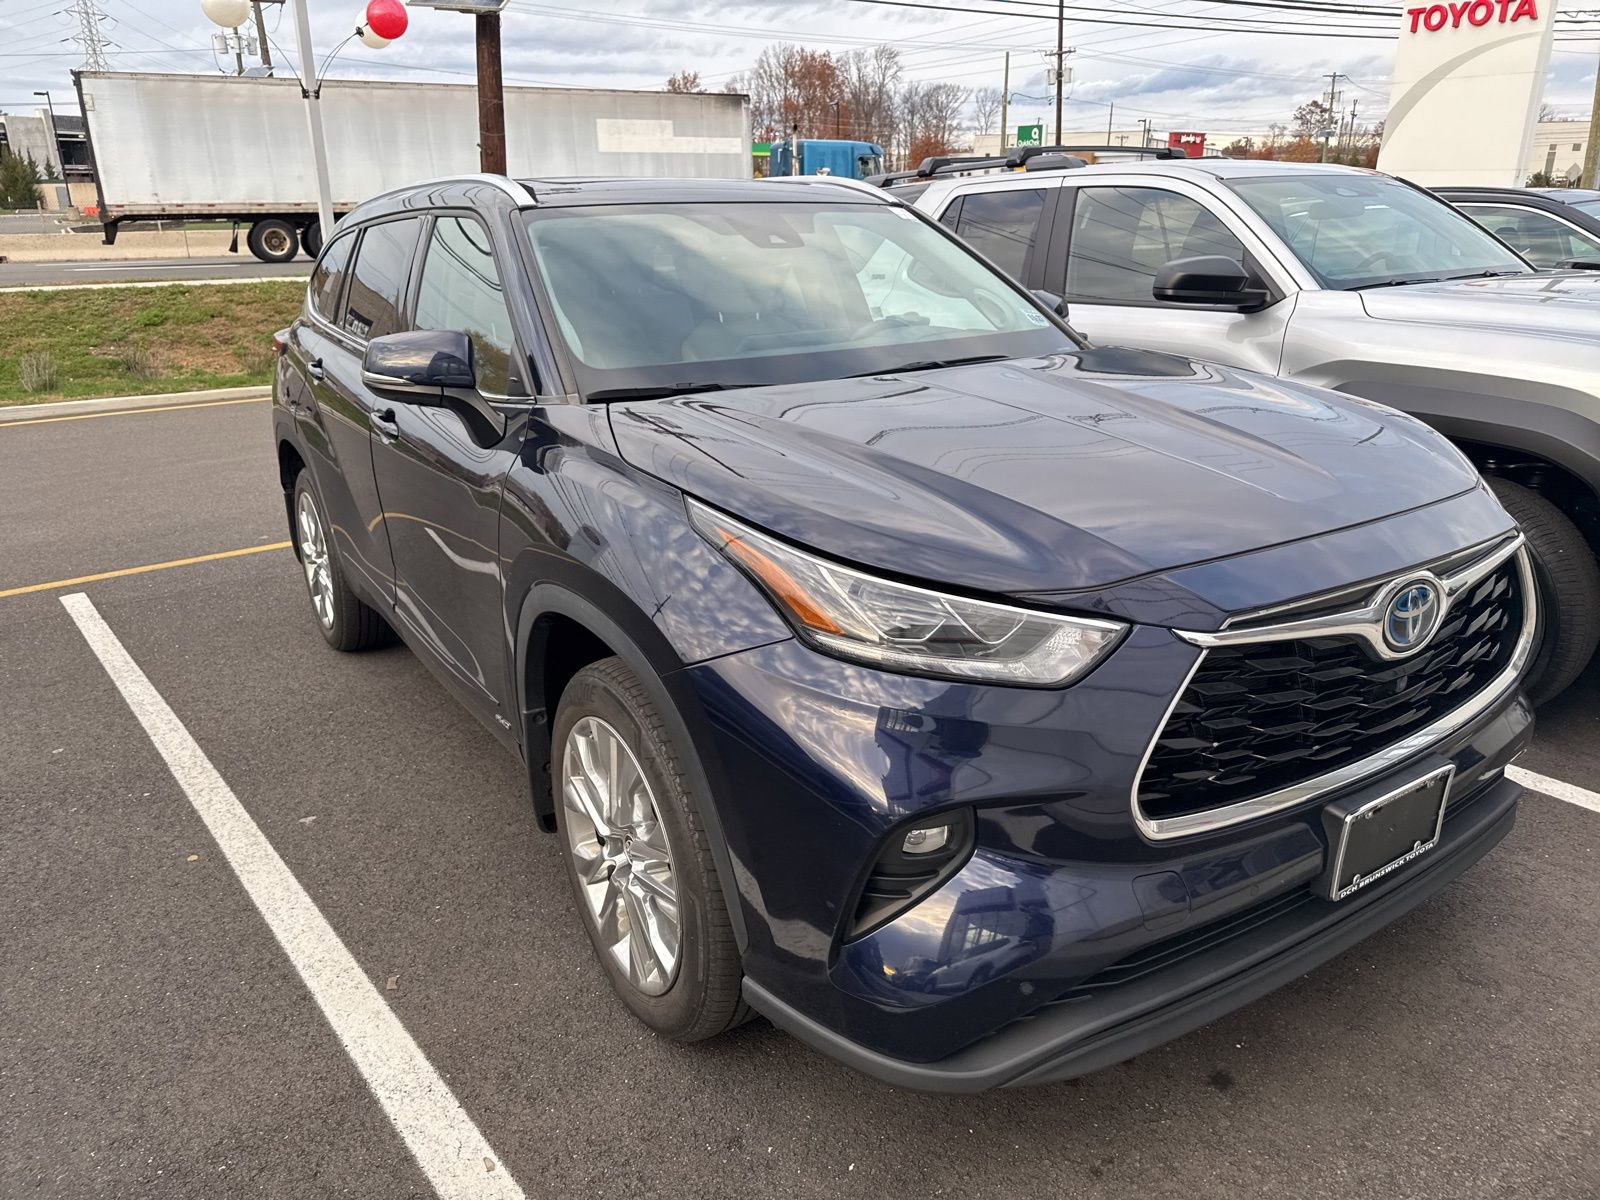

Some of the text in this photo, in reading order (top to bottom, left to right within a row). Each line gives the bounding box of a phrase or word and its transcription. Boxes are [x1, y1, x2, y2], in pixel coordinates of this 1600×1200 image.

[1407, 0, 1538, 33] TOYOTA
[1340, 842, 1434, 898] DCH BRUNSWICK TOYOTA
